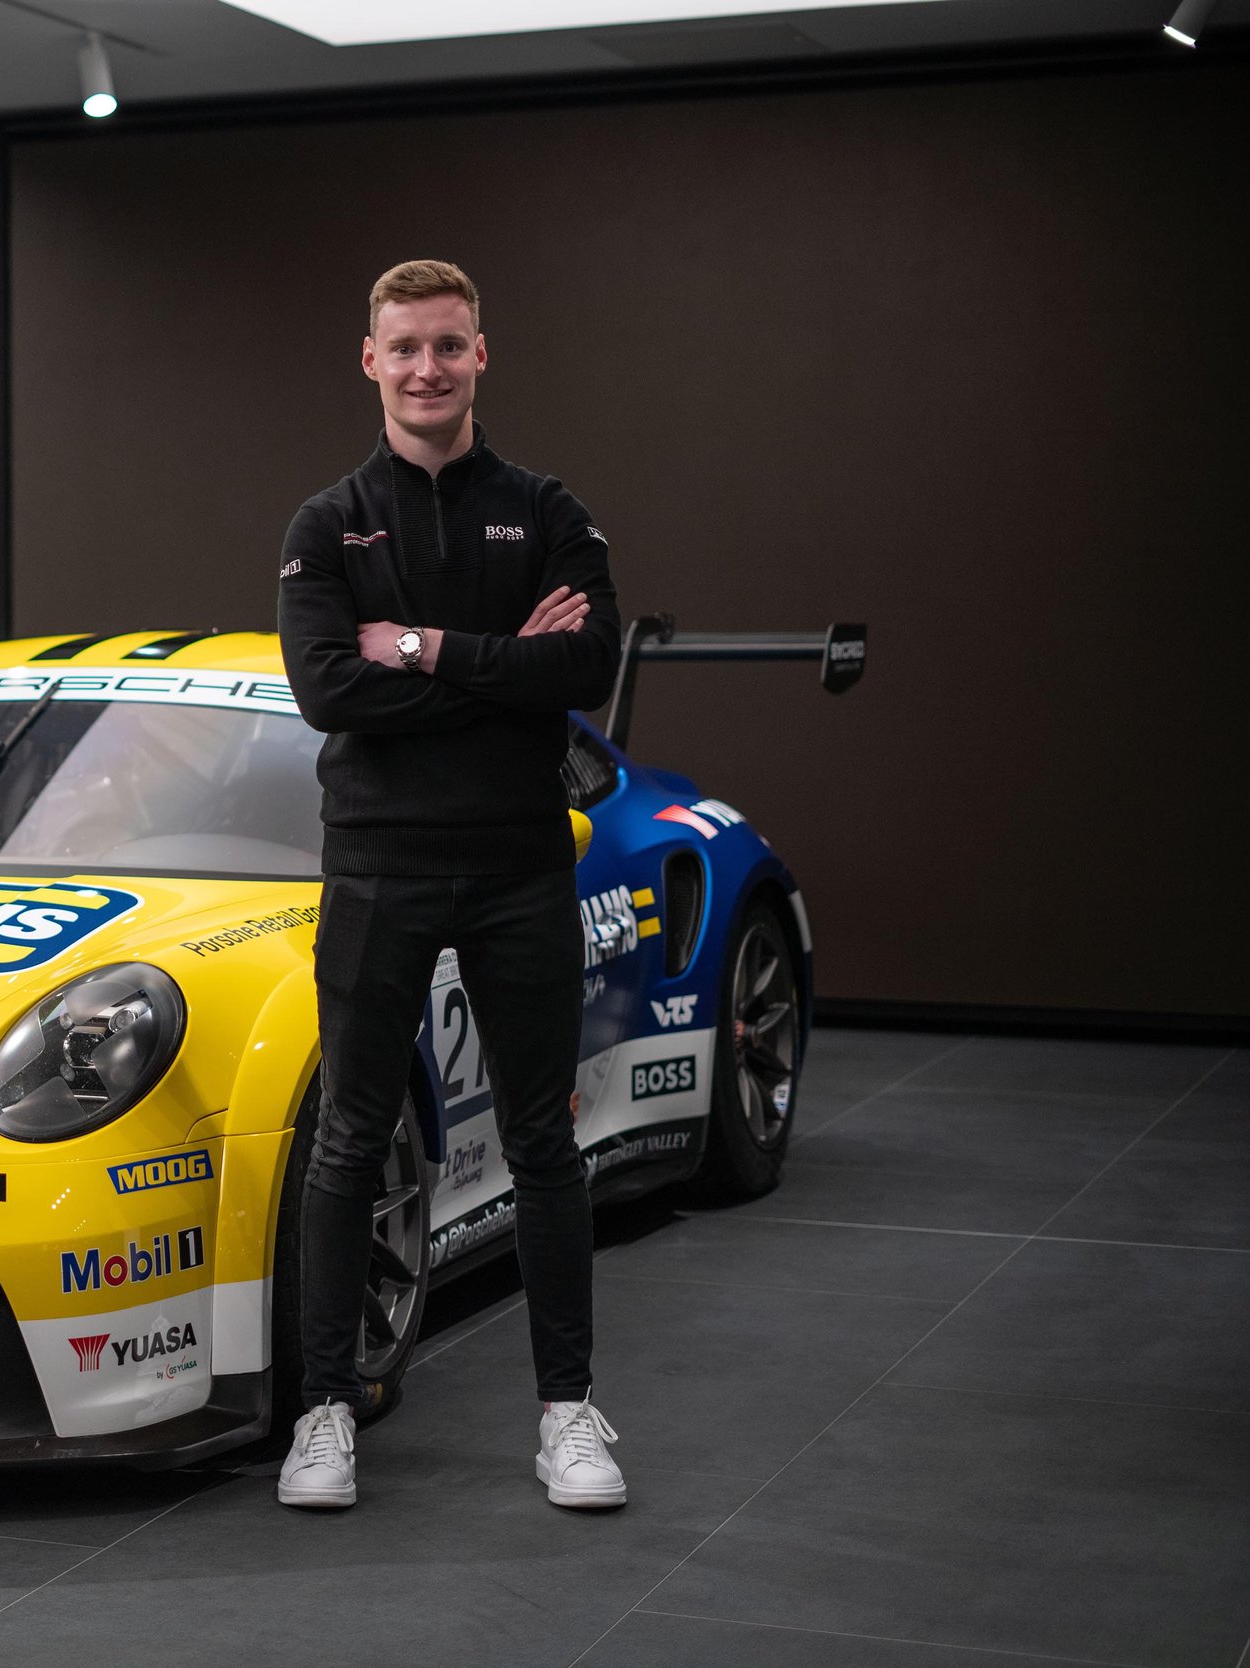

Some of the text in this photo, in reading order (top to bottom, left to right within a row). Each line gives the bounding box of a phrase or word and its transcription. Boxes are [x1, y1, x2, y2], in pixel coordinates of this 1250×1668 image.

[485, 525, 524, 536] BOSS
[179, 906, 322, 957] Porsche Retail Gro
[634, 1060, 693, 1096] BOSS
[453, 1139, 486, 1175] Drive
[646, 1132, 691, 1153] VALLEY
[116, 1154, 207, 1191] MOOG
[446, 1201, 516, 1258] @PorscheRac
[60, 1233, 172, 1294] Mobil
[111, 1322, 197, 1367] YUASA
[156, 1371, 164, 1380] by
